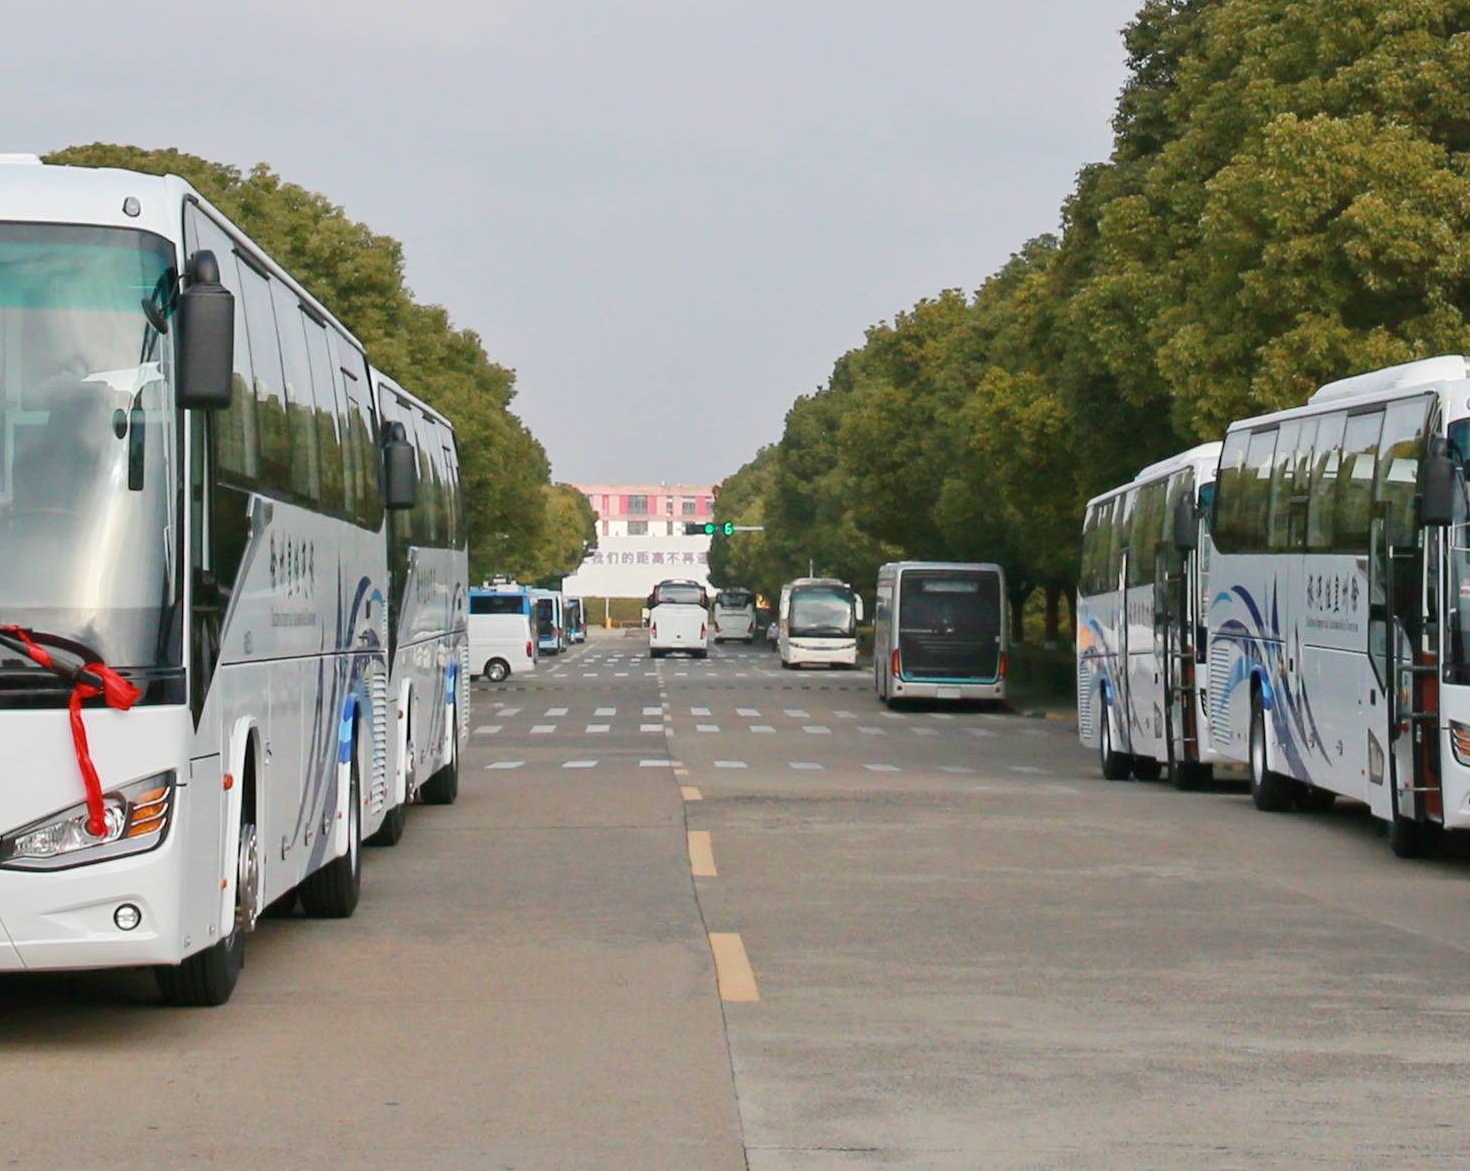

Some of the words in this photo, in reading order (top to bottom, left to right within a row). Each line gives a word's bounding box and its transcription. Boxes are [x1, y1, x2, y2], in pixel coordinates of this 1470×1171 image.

[724, 522, 733, 535] 6
[583, 551, 709, 564] 我们的距离不再遥
